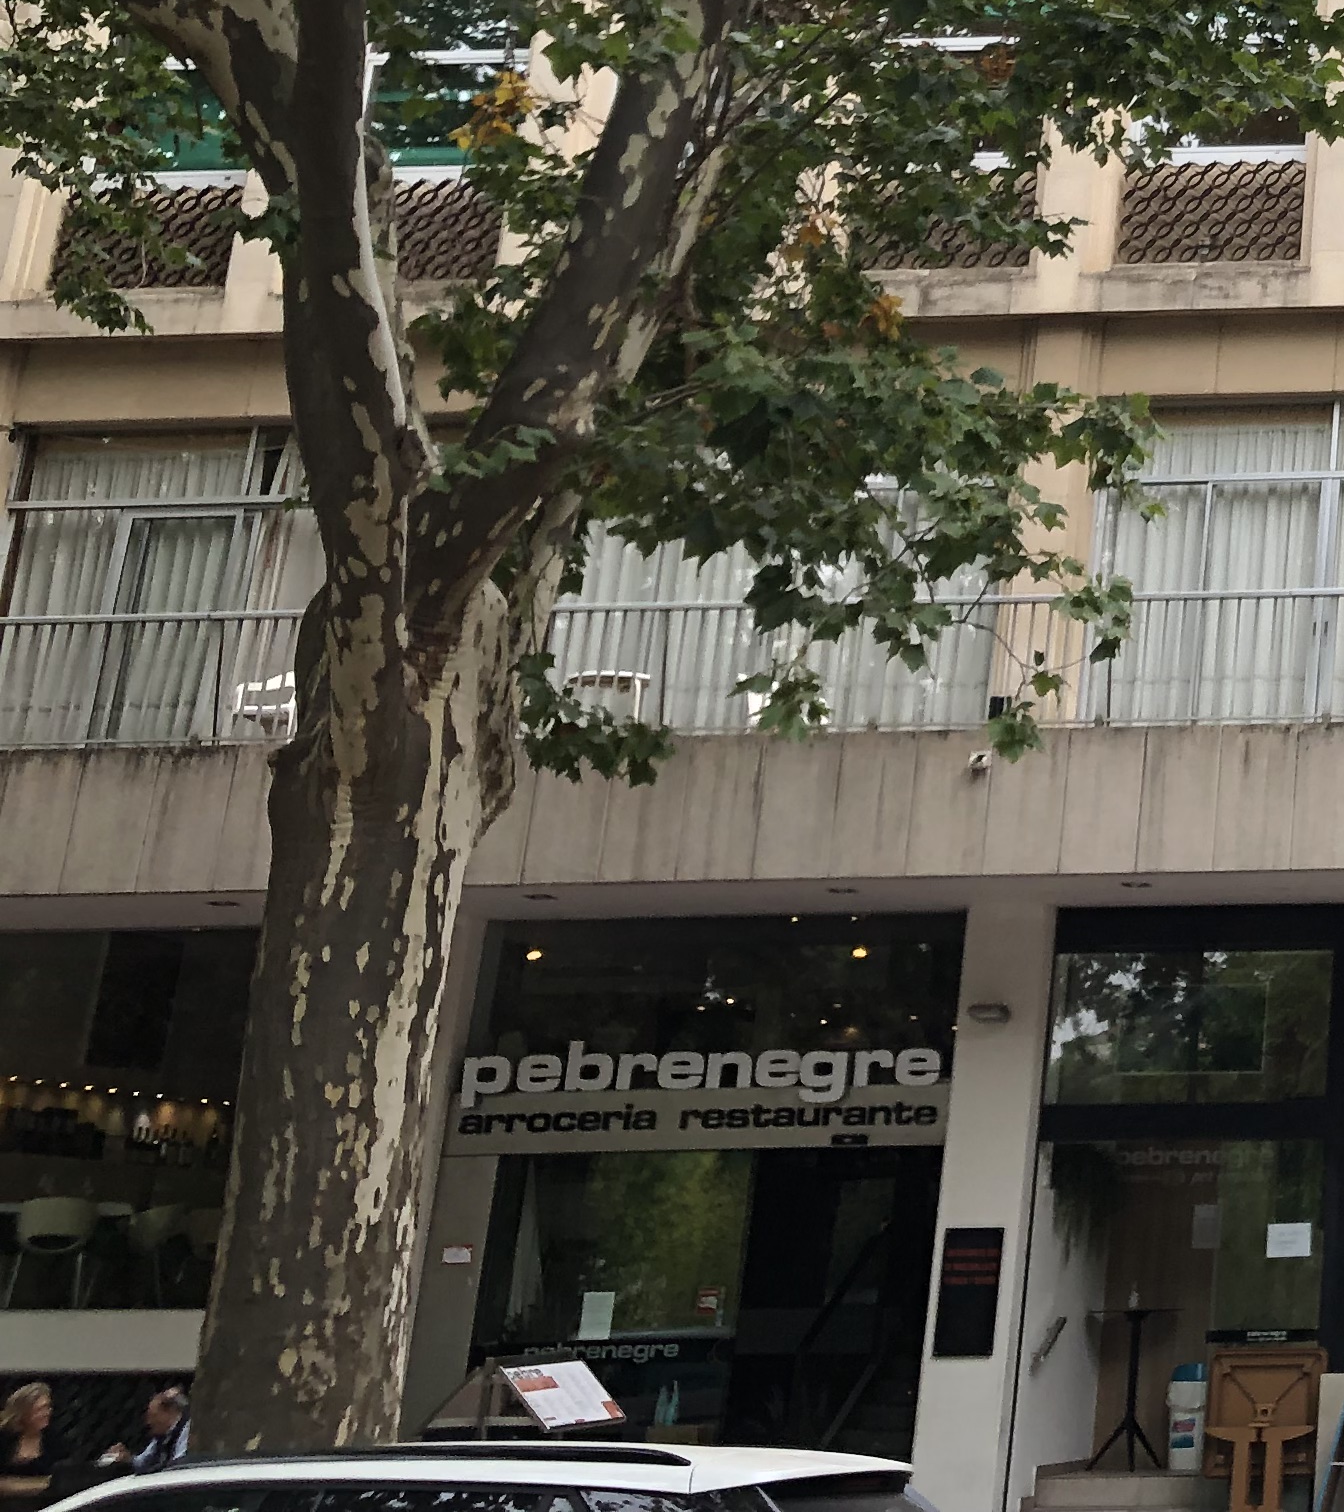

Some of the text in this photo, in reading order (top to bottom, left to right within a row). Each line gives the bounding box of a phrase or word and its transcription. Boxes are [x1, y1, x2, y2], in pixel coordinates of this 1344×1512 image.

[459, 1040, 942, 1109] pebrenegre
[457, 1100, 939, 1136] arroceria restaurante
